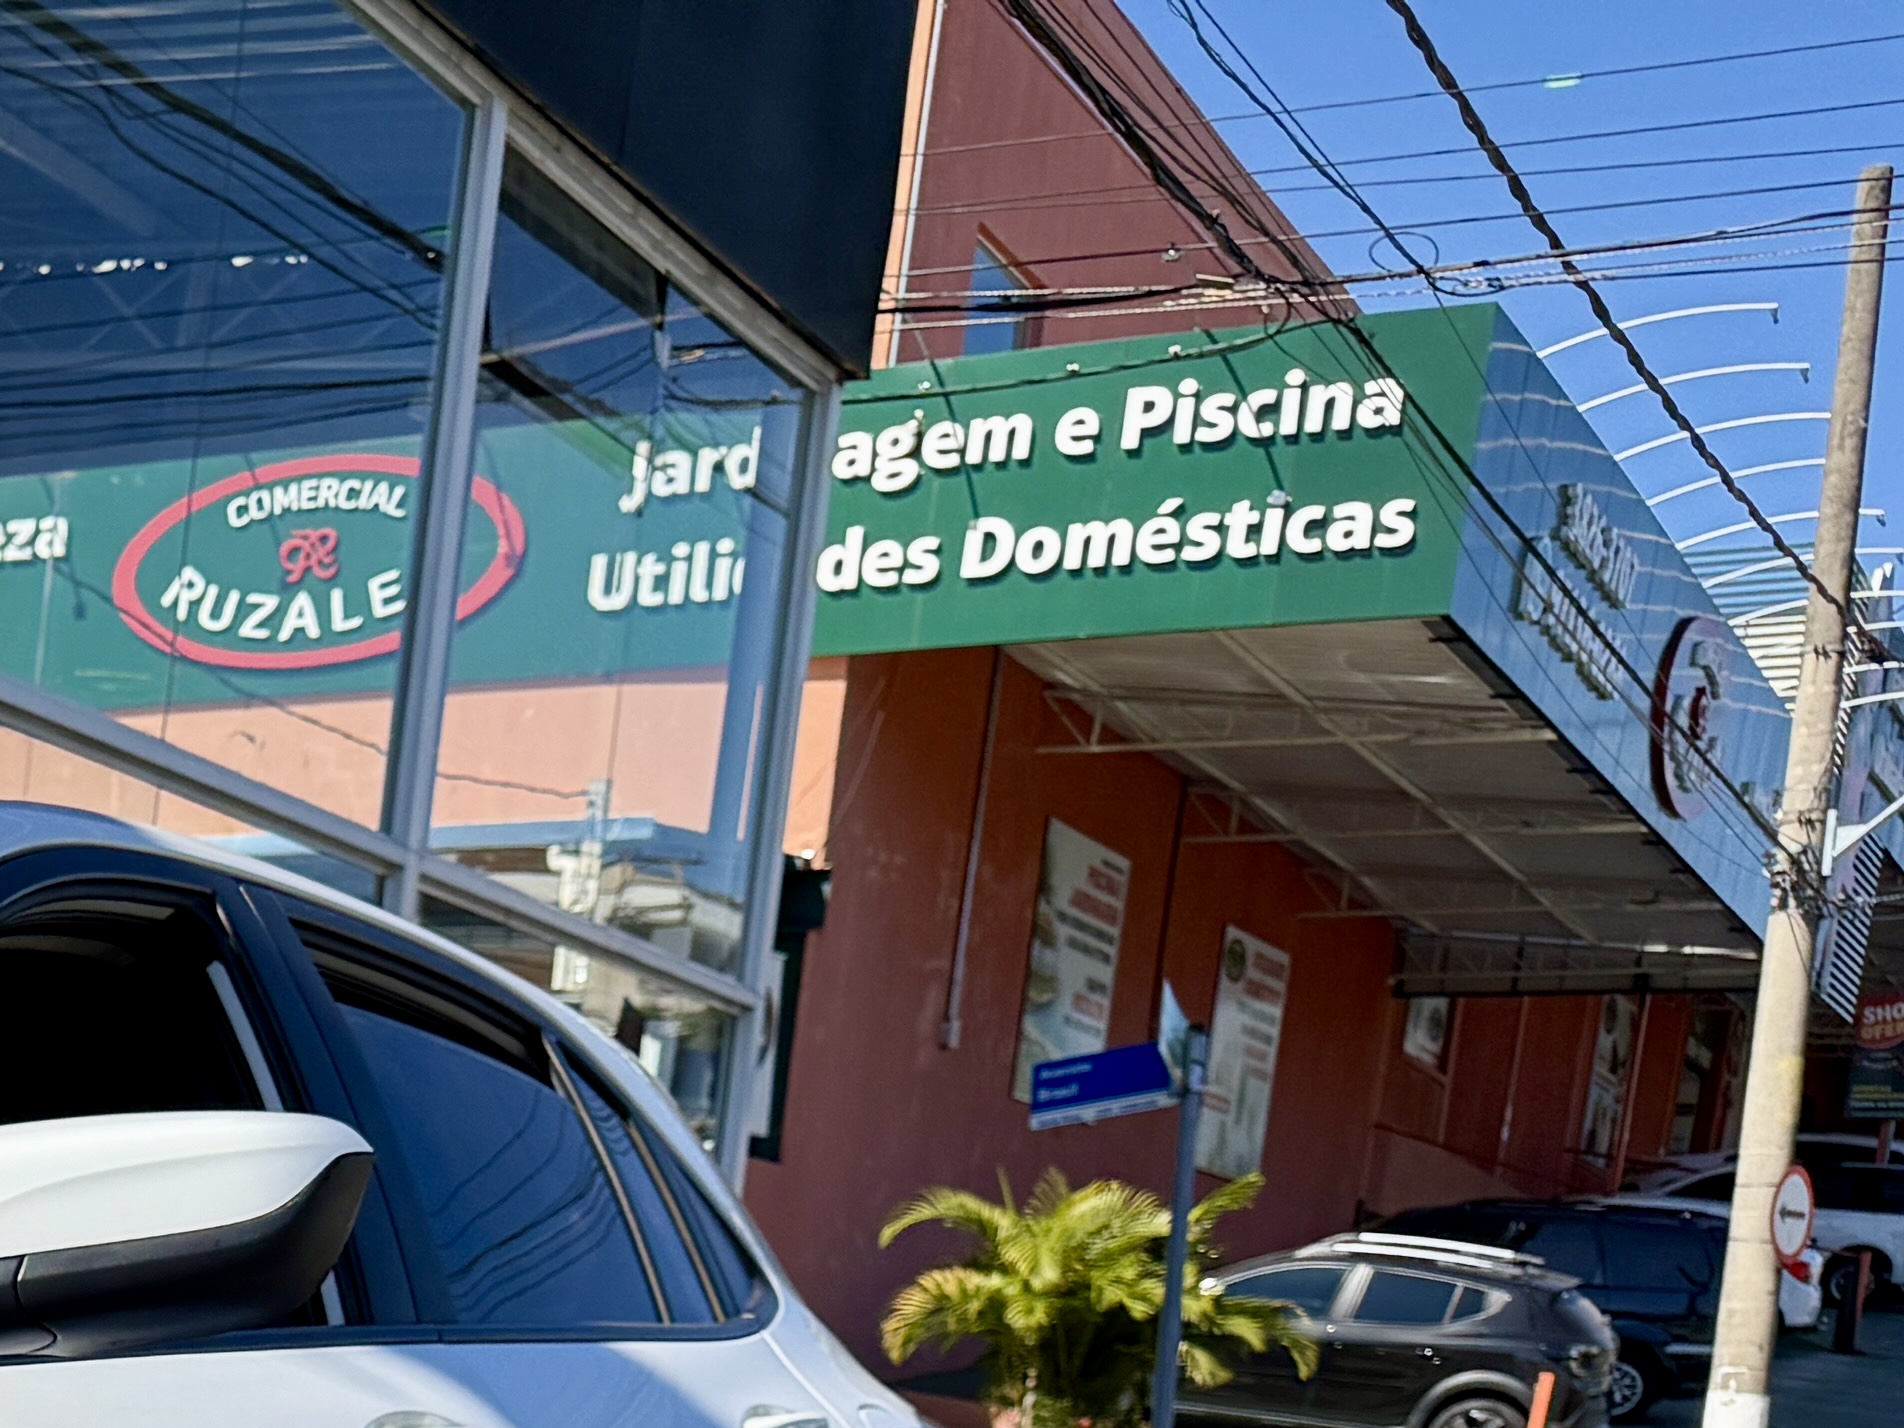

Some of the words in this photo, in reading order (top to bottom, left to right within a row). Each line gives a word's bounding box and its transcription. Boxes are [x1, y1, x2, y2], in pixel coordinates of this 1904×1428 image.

[618, 412, 1033, 513] Jardagem
[1054, 406, 1100, 457] e
[1120, 367, 1404, 451] Piscina
[226, 477, 408, 528] COMERCIAL
[587, 524, 942, 611] Utilides
[959, 496, 1416, 579] Domésticas
[160, 565, 408, 643] RUZALE
